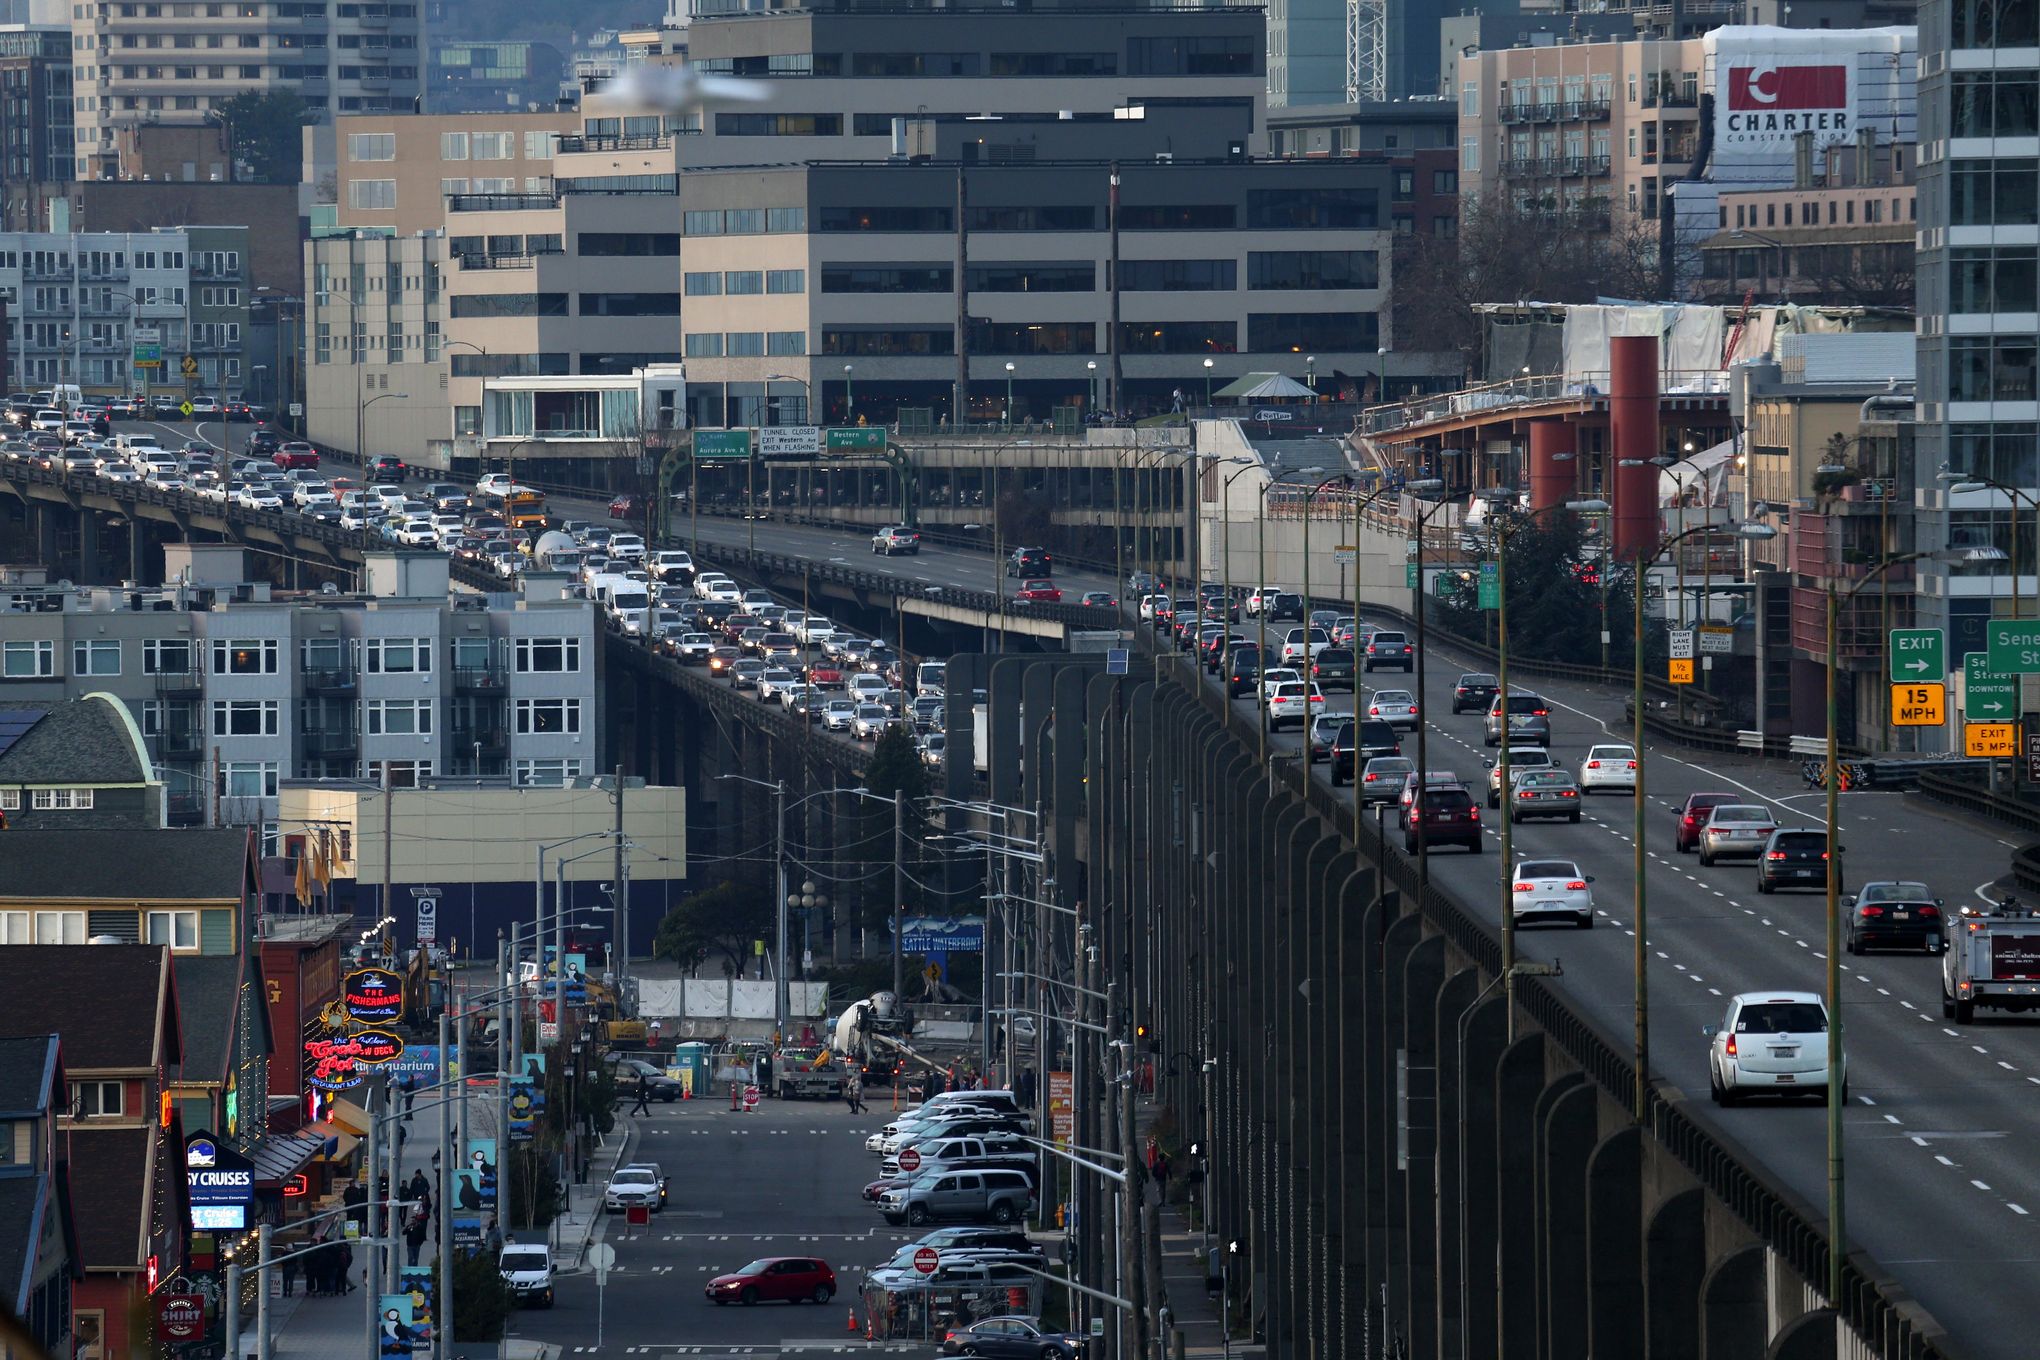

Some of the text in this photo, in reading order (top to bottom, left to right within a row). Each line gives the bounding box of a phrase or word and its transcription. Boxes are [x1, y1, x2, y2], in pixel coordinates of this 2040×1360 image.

[1728, 113, 1846, 131] CHARTER
[1727, 132, 1847, 142] CONSTRUION
[1899, 638, 1935, 650] EXIT
[1998, 632, 2040, 646] Sene
[2020, 650, 2040, 664] St
[1907, 690, 1928, 704] 15
[1901, 708, 1936, 720] MPH
[1981, 729, 2006, 738] EXIT
[1972, 742, 1984, 751] 15
[423, 902, 430, 912] P
[932, 937, 981, 951] WATERFRONT
[346, 994, 400, 1006] FISHERMANS
[304, 1038, 362, 1058] Crab
[374, 1044, 394, 1056] DECK
[314, 1055, 354, 1078] Pot
[376, 1062, 434, 1072] Aquarium
[310, 1076, 346, 1089] RESTAURANT
[200, 1172, 250, 1186] CRUISES
[161, 1310, 201, 1321] SHIRT
